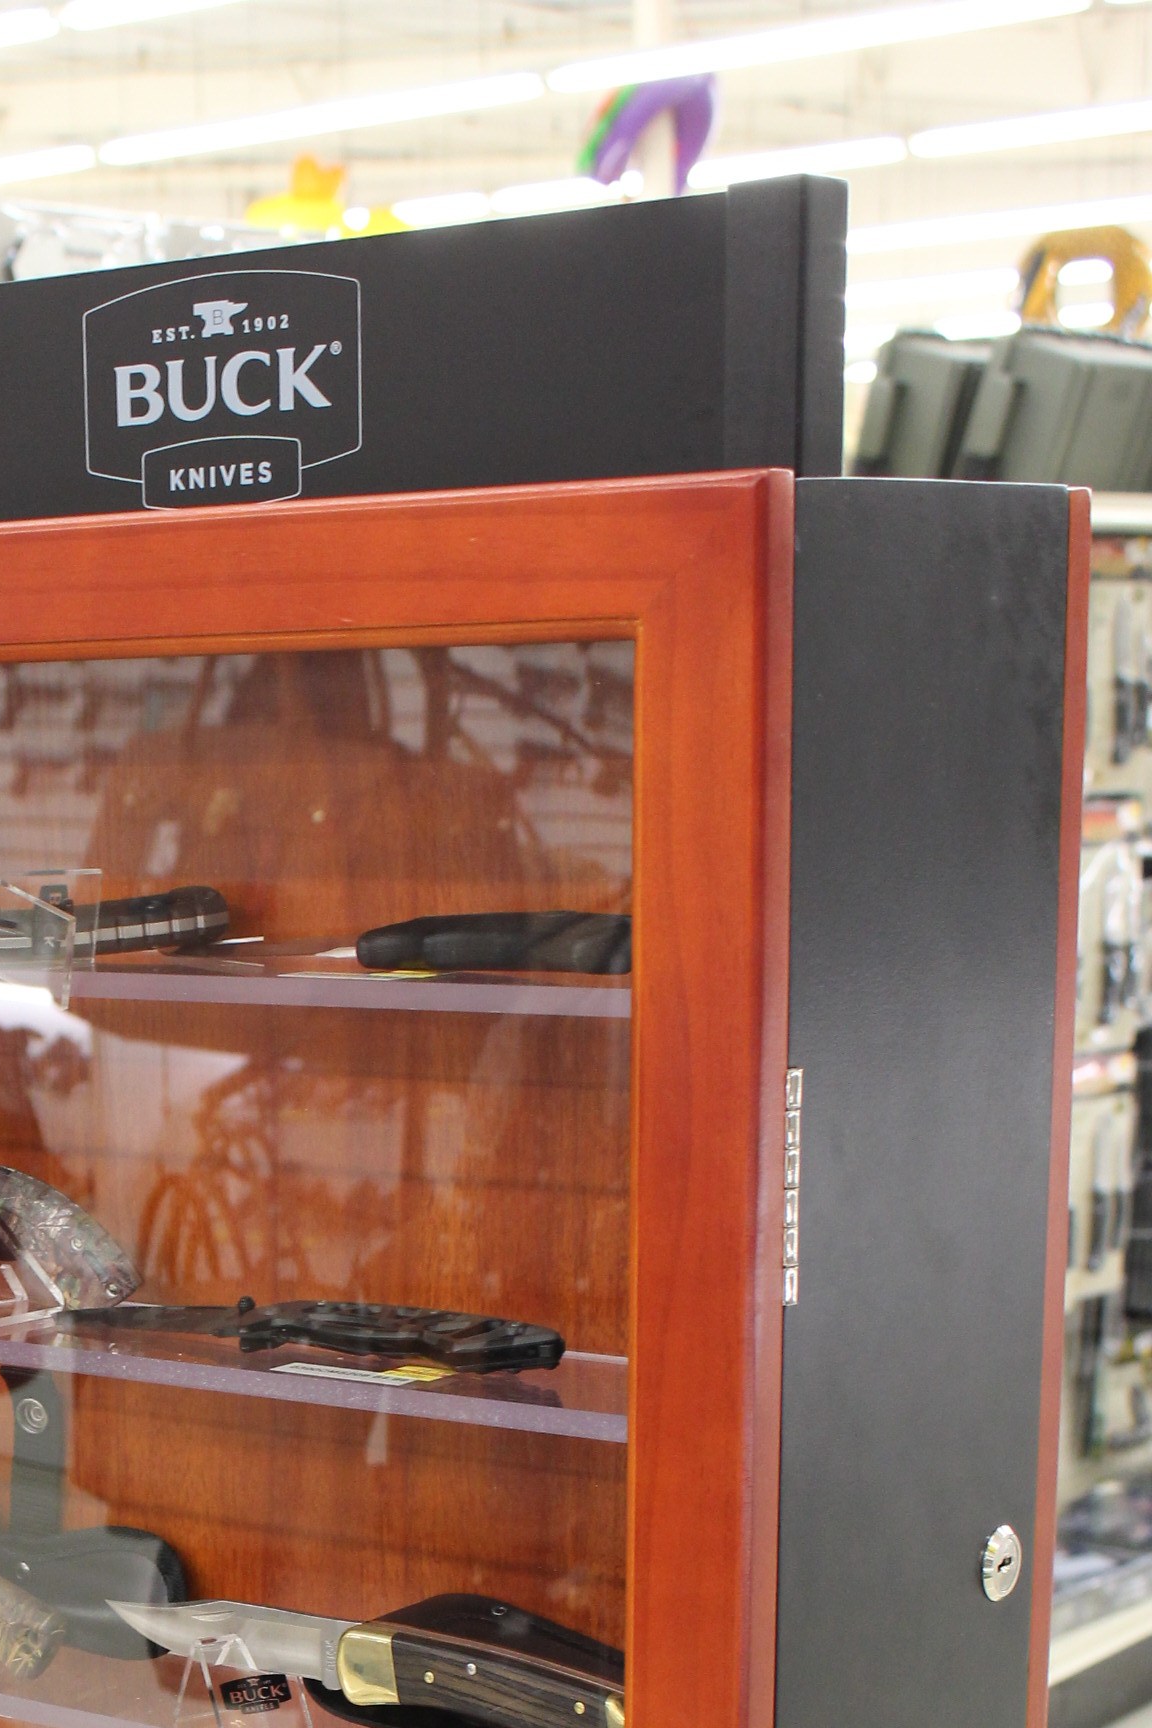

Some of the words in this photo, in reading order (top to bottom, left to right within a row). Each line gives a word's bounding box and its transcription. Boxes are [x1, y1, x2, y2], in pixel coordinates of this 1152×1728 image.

[152, 326, 195, 343] EST.
[242, 314, 289, 333] 1902
[113, 344, 333, 427] BUCK
[169, 461, 273, 491] KNIVES
[229, 1685, 285, 1704] BUCK
